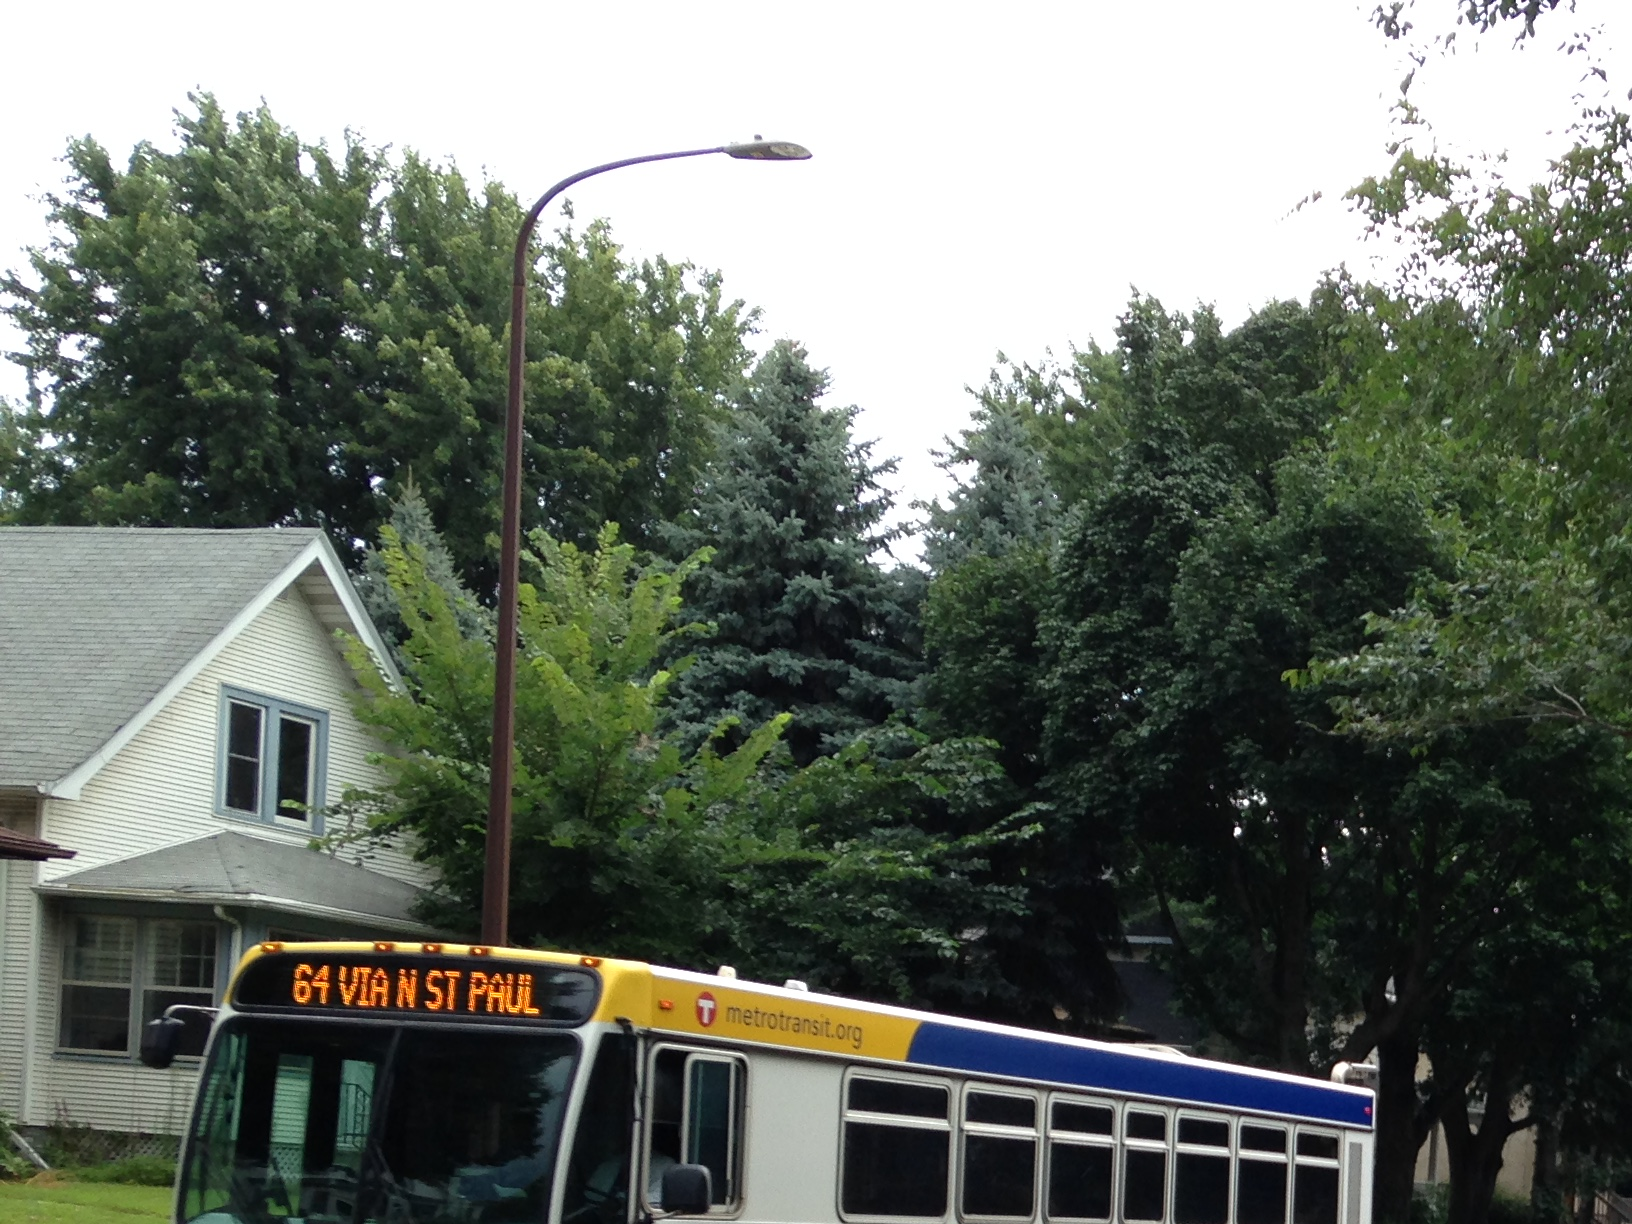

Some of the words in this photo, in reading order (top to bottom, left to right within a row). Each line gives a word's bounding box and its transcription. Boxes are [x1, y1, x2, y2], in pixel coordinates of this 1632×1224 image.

[293, 963, 330, 1005] 64
[338, 966, 389, 1007] VIA
[396, 968, 418, 1009] N
[424, 969, 461, 1012] ST
[467, 971, 540, 1015] PAUL
[725, 1005, 863, 1050] metrotransit.org
